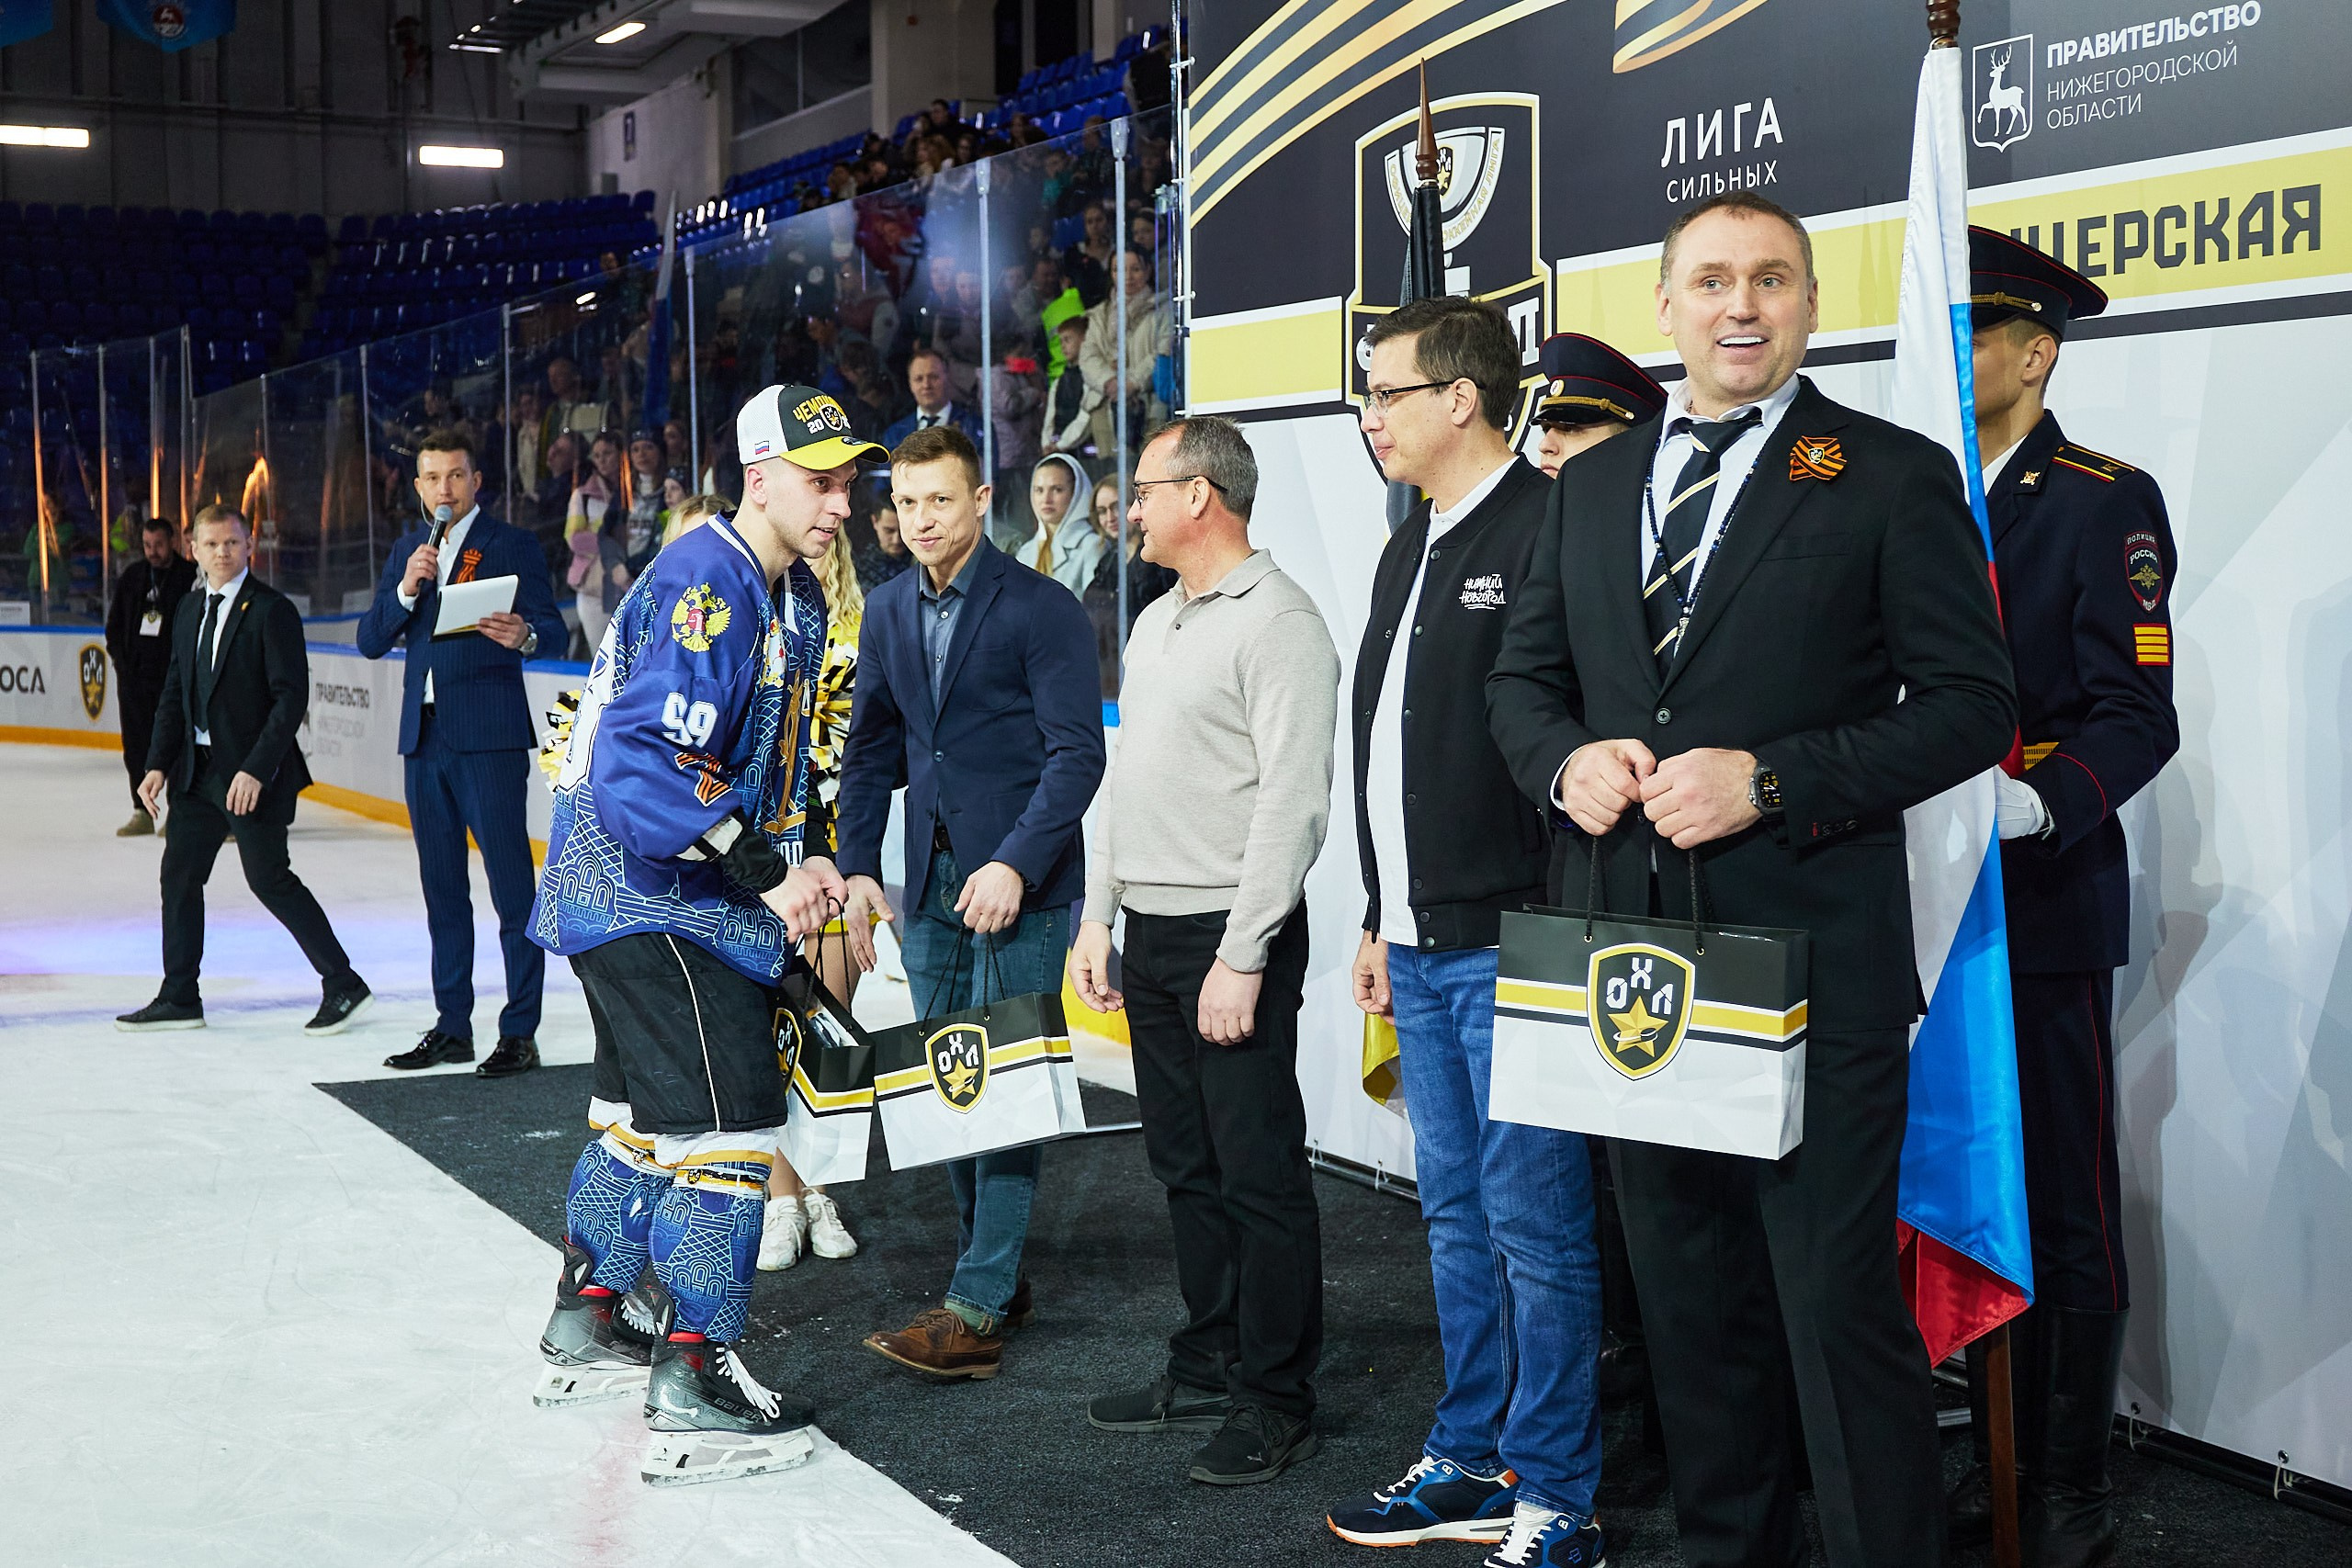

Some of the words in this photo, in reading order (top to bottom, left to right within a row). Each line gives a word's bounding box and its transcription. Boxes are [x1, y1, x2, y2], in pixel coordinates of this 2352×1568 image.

[2047, 0, 2262, 68] ПРАВИТЕЛЬСТВО
[2047, 39, 2238, 103] НИЖЕГОРОДСКОЙ
[1660, 96, 1783, 168] ЛИГА
[2047, 93, 2142, 130] ОБЛАСТИ
[1666, 159, 1778, 203] СИЛЬНЫХ
[1442, 186, 1488, 243] ОККЕЙНАЯ
[1605, 956, 1674, 1016] ОХЛ
[937, 1032, 980, 1074] ОХЛ
